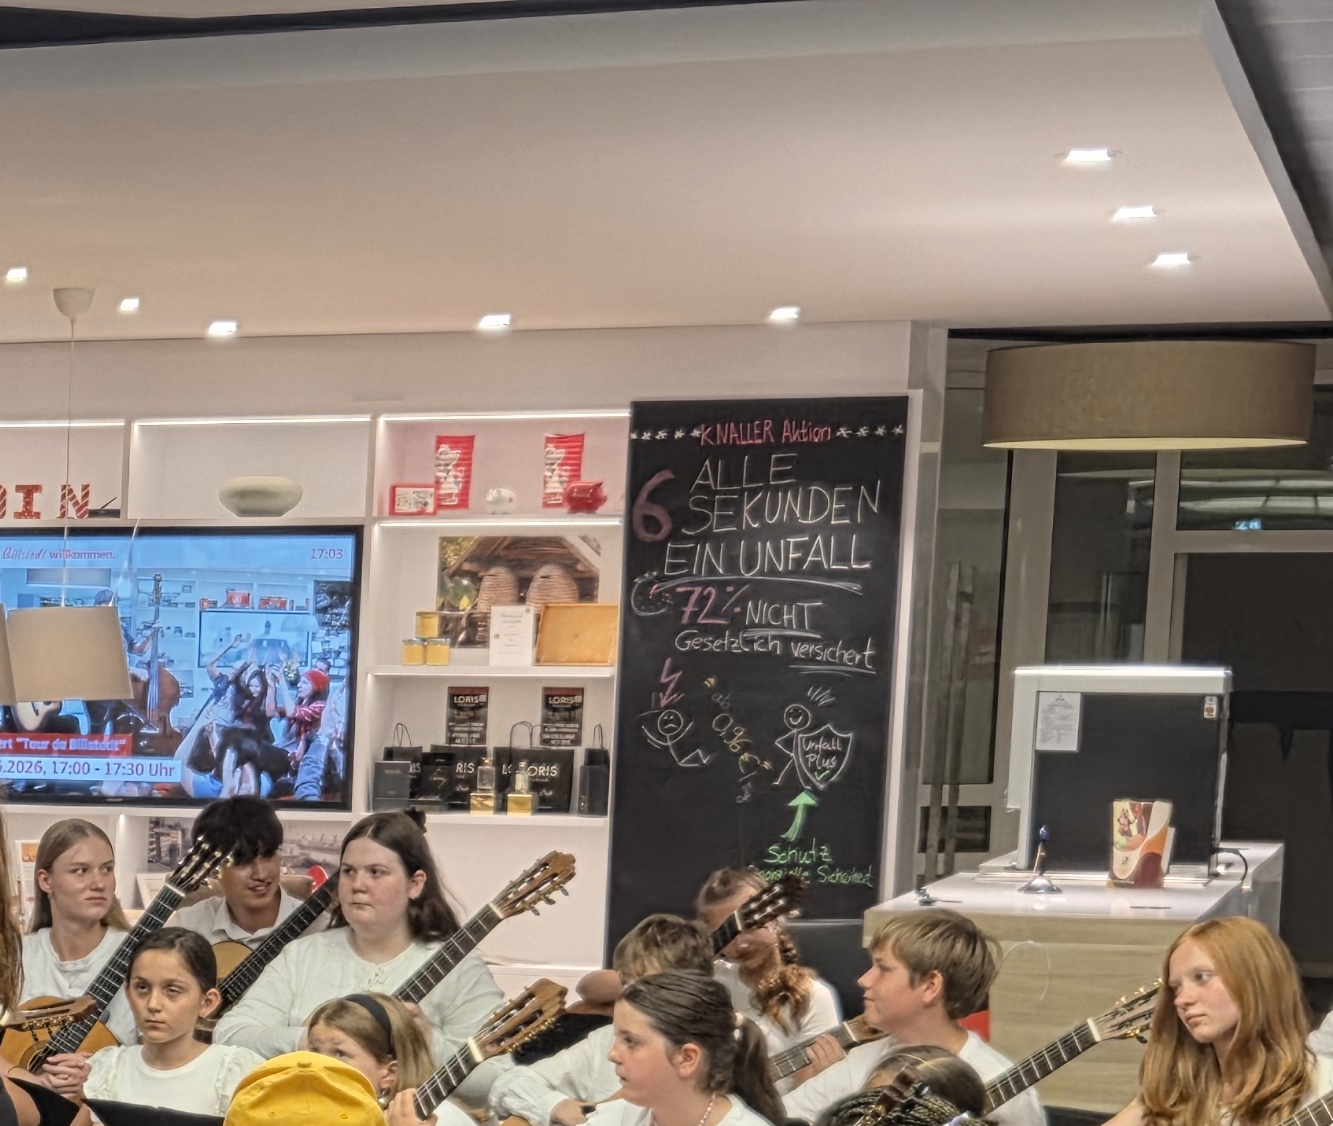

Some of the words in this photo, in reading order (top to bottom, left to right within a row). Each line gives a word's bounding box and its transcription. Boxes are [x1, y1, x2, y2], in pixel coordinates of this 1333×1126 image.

[700, 419, 775, 445] KNALLER
[782, 418, 831, 443] Aktion
[689, 453, 798, 493] ALLE
[634, 469, 676, 542] 6
[681, 479, 881, 535] SEKUNDEN
[50, 549, 115, 560] willkommen.
[310, 548, 343, 560] 17:03
[664, 541, 727, 577] EIN
[739, 534, 872, 577] UNFALL
[675, 584, 750, 625] 72%
[745, 599, 823, 631] NICHT
[674, 629, 781, 655] Gesetzlich
[790, 637, 876, 669] versichert
[453, 695, 479, 703] LORIS
[802, 736, 842, 752] Unfall
[52, 760, 91, 775] 17:00
[105, 762, 144, 776] 17:30
[149, 762, 175, 777] Uhr
[527, 765, 558, 777] ORIS
[805, 754, 837, 769] Plus
[763, 837, 834, 864] Schutz
